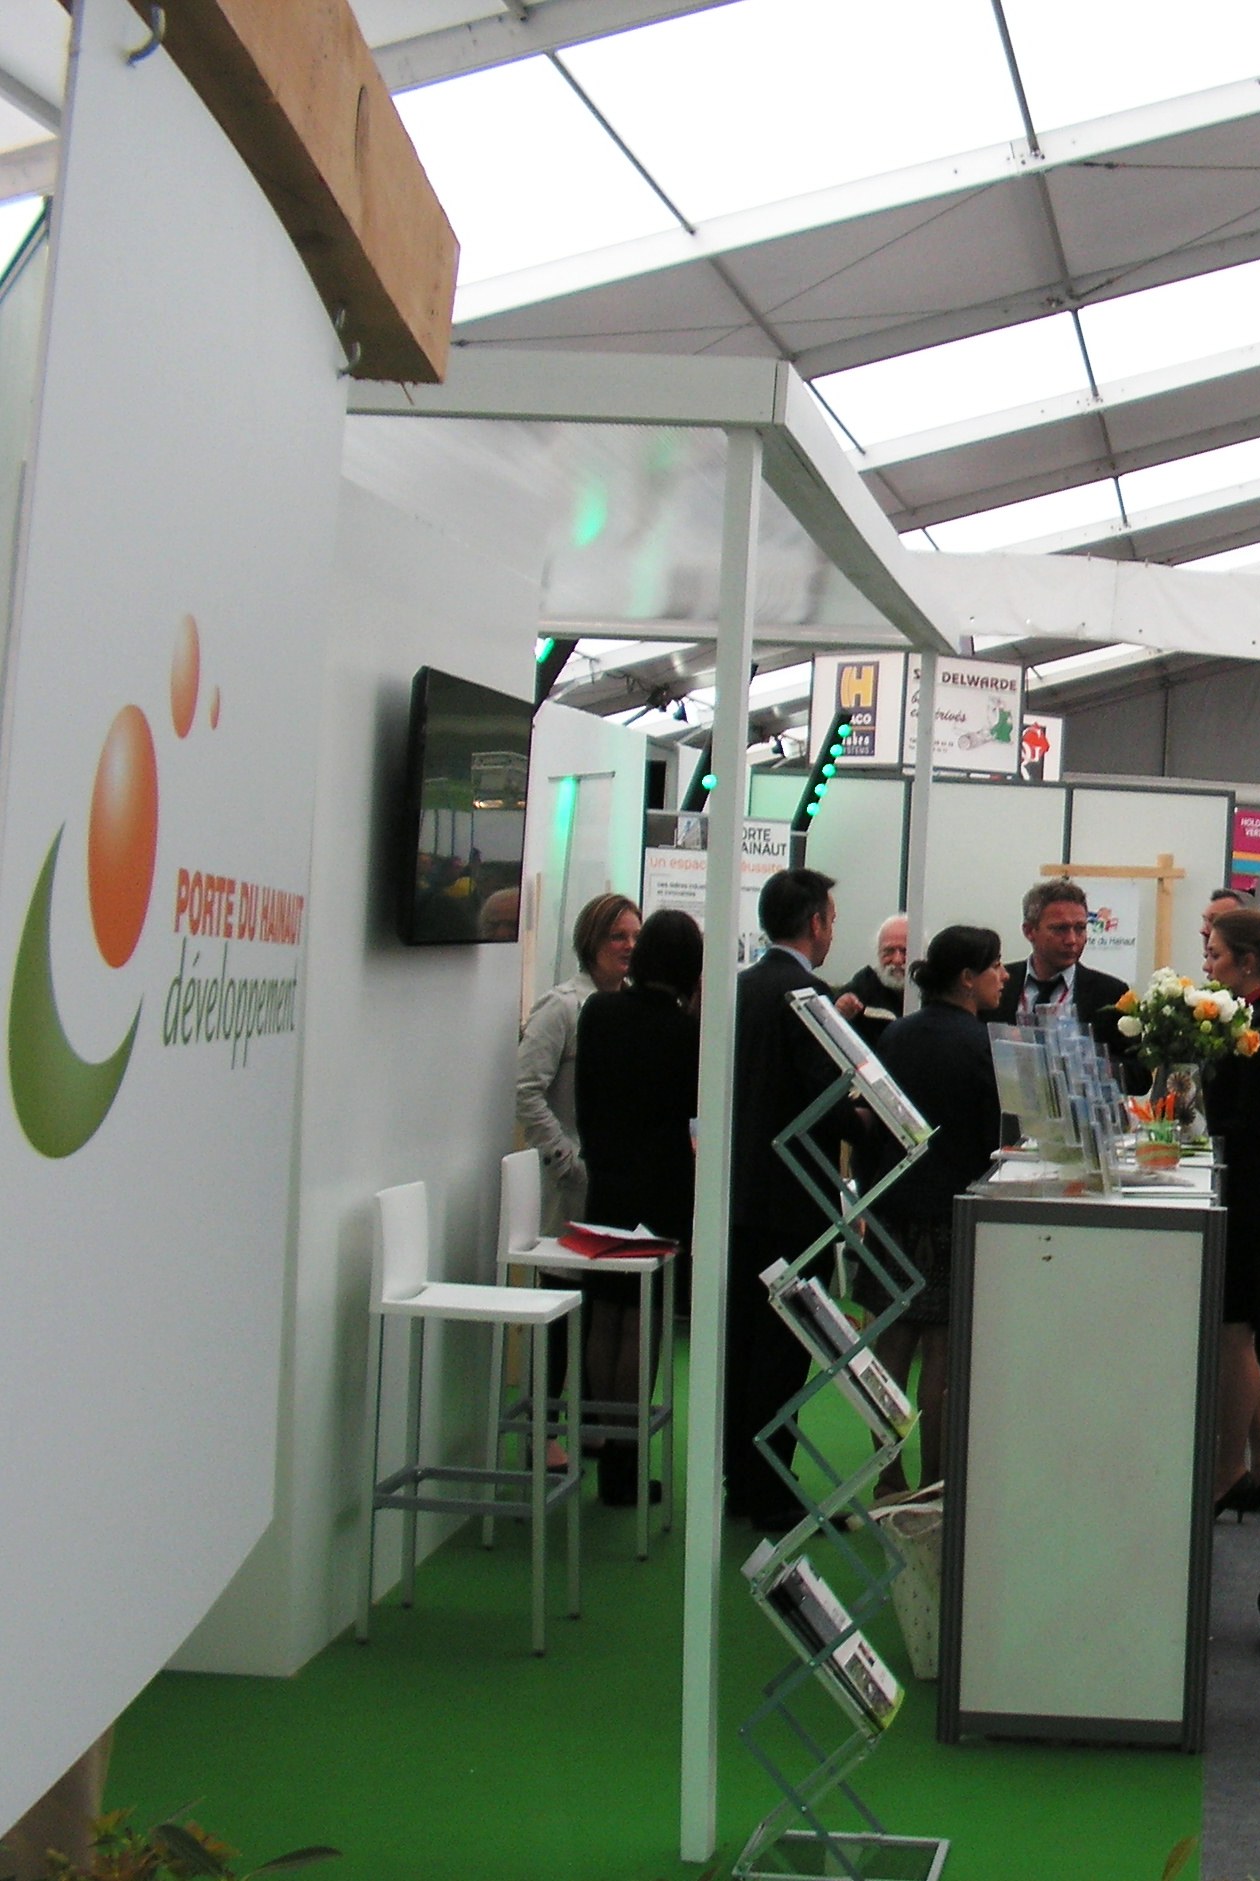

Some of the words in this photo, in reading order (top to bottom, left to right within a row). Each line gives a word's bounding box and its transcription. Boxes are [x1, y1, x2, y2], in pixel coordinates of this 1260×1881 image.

[941, 671, 1017, 692] DELWARDE
[848, 712, 872, 725] ACO
[741, 842, 787, 857] AINAUT
[669, 859, 706, 871] espac
[174, 867, 237, 939] PORTE
[237, 881, 260, 942] DU
[259, 886, 305, 946] HAINAUT
[163, 935, 297, 1070] développement
